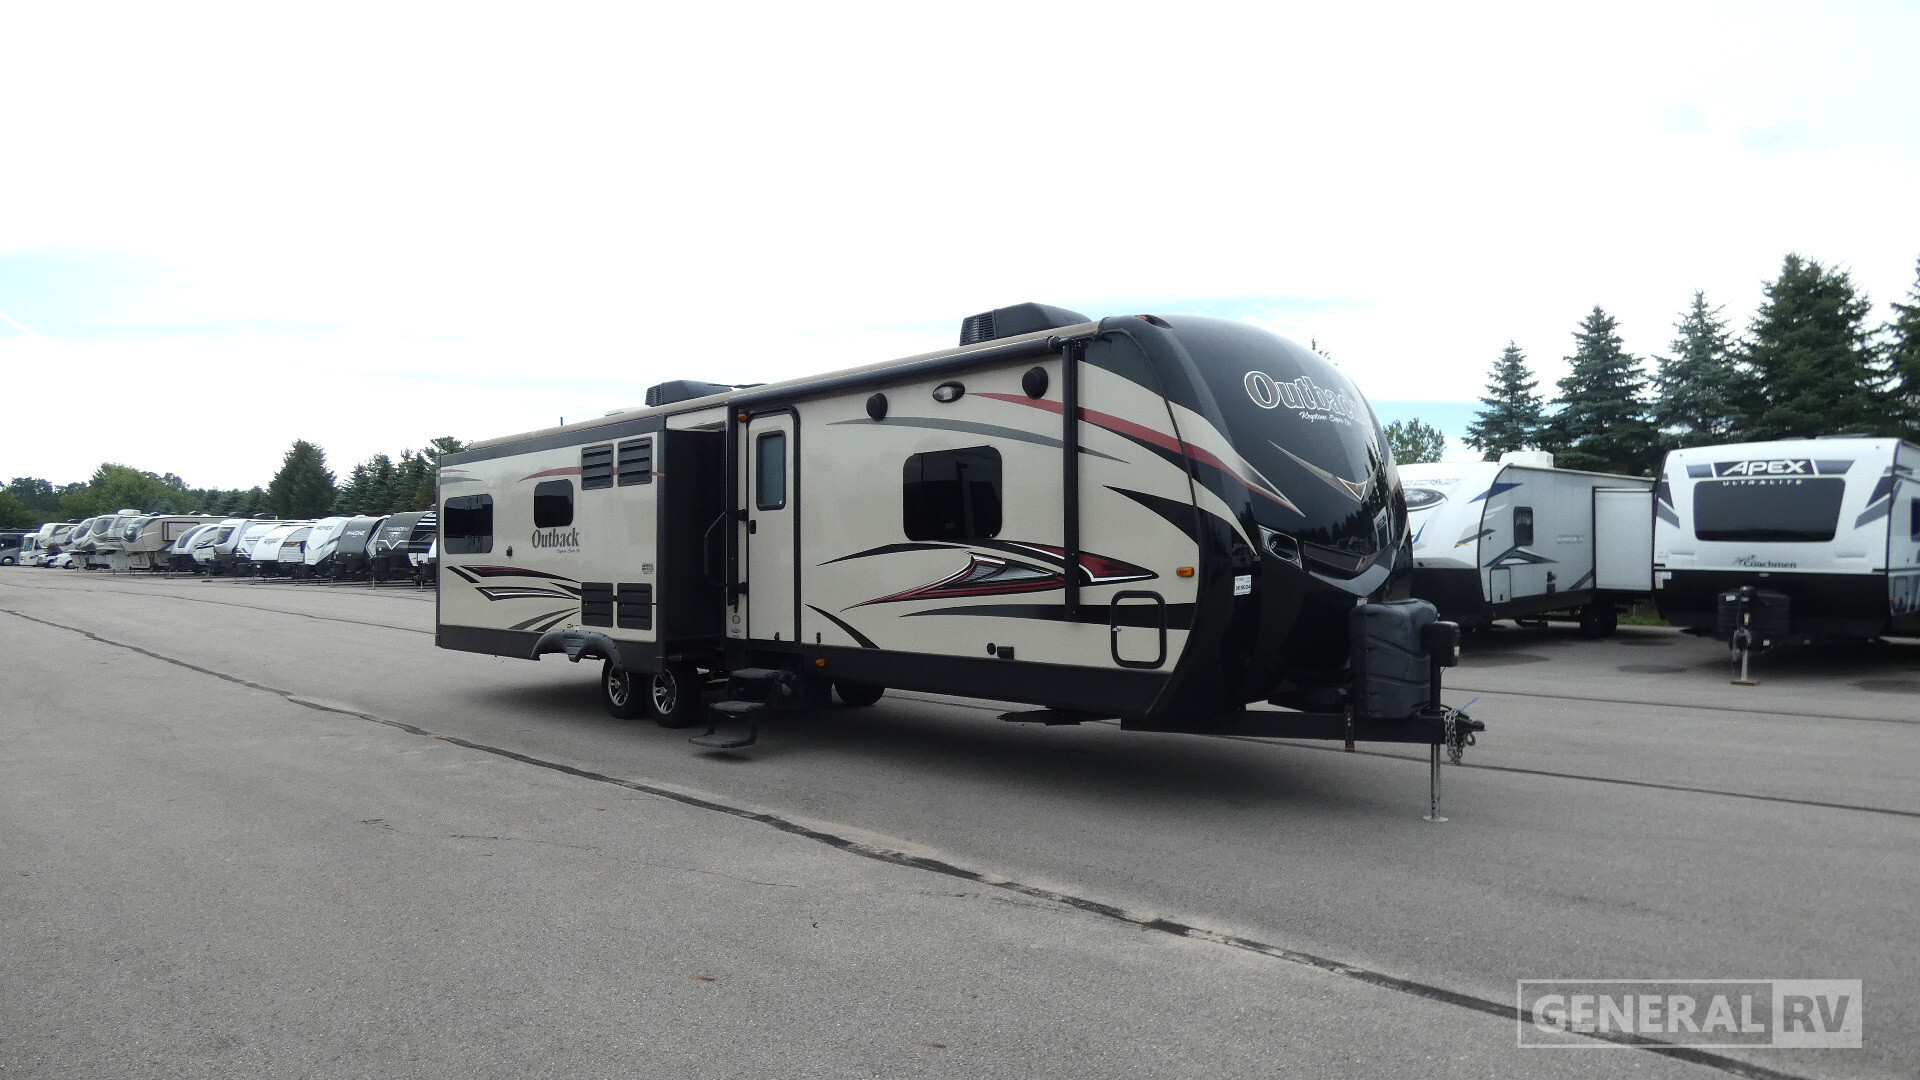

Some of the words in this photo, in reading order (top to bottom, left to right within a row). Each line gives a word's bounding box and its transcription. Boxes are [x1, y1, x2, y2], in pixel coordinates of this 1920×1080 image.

[1244, 370, 1365, 424] Outback
[1722, 460, 1807, 476] APEX
[532, 527, 580, 549] Outback
[1743, 559, 1798, 569] Coachmen
